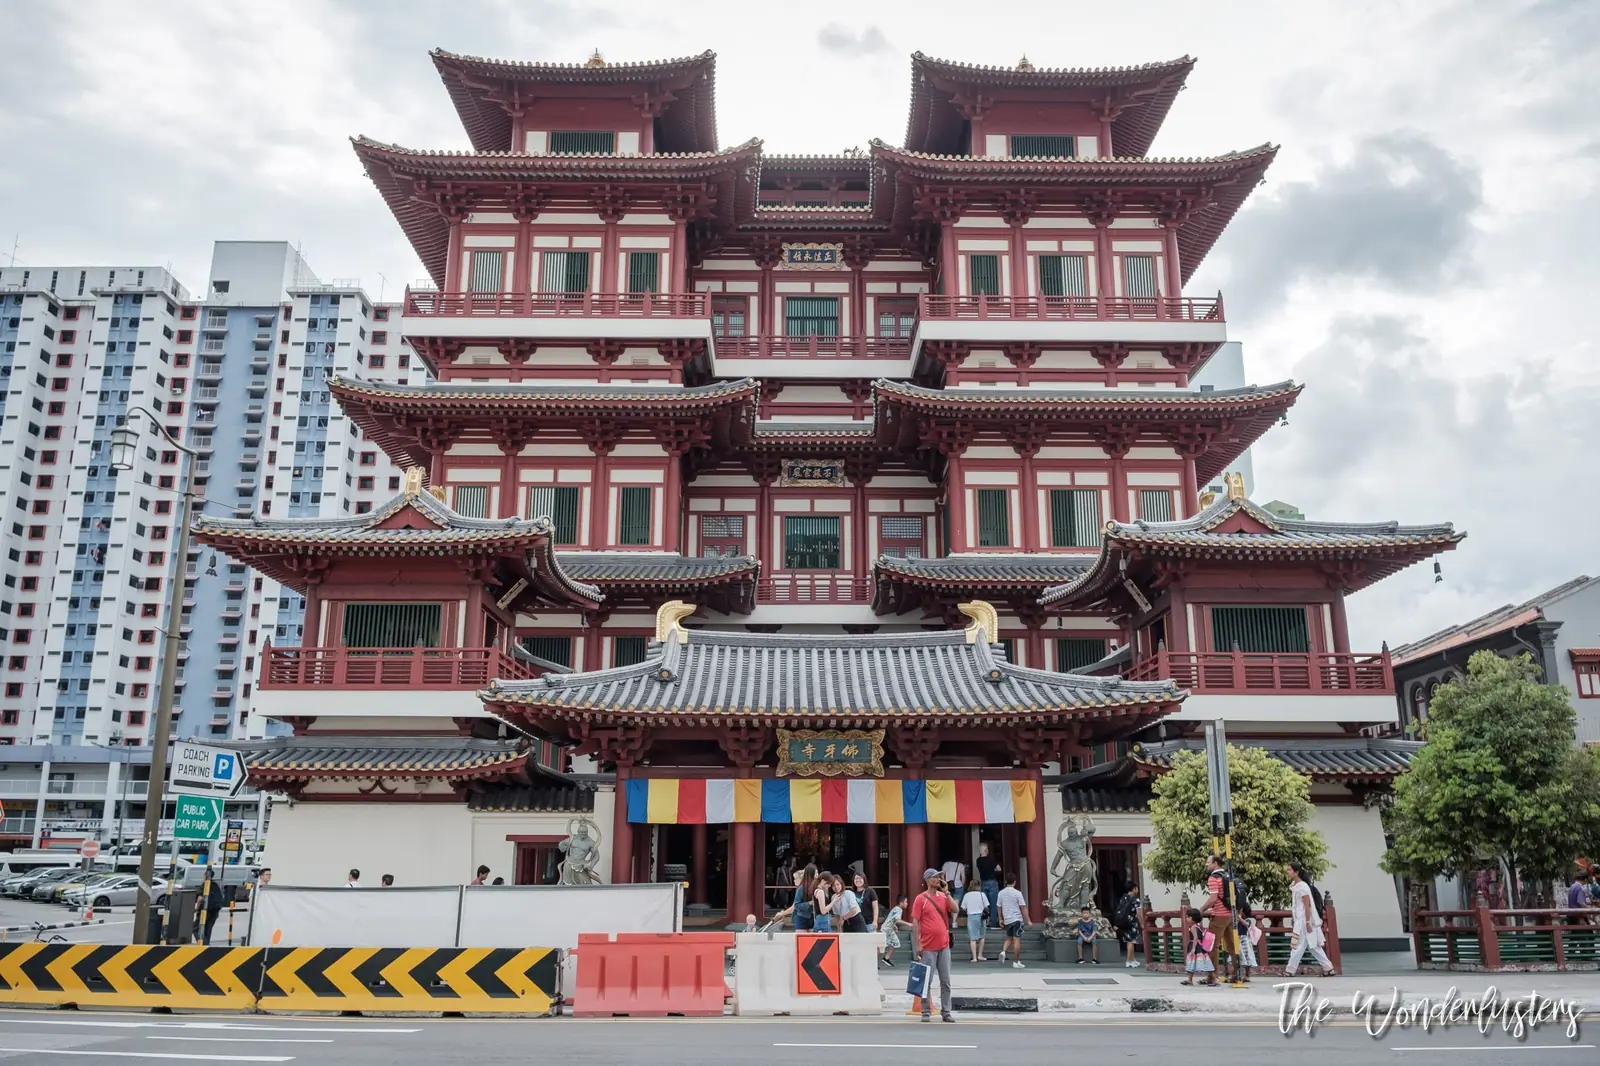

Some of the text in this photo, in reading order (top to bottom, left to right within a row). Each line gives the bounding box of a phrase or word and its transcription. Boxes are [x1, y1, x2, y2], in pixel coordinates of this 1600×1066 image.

[183, 748, 210, 762] COACH
[801, 743, 859, 760] 佛牙寺
[177, 763, 211, 778] PARKING
[217, 758, 230, 775] P
[182, 804, 207, 816] PUBLIC
[175, 818, 210, 831] CAR PARK
